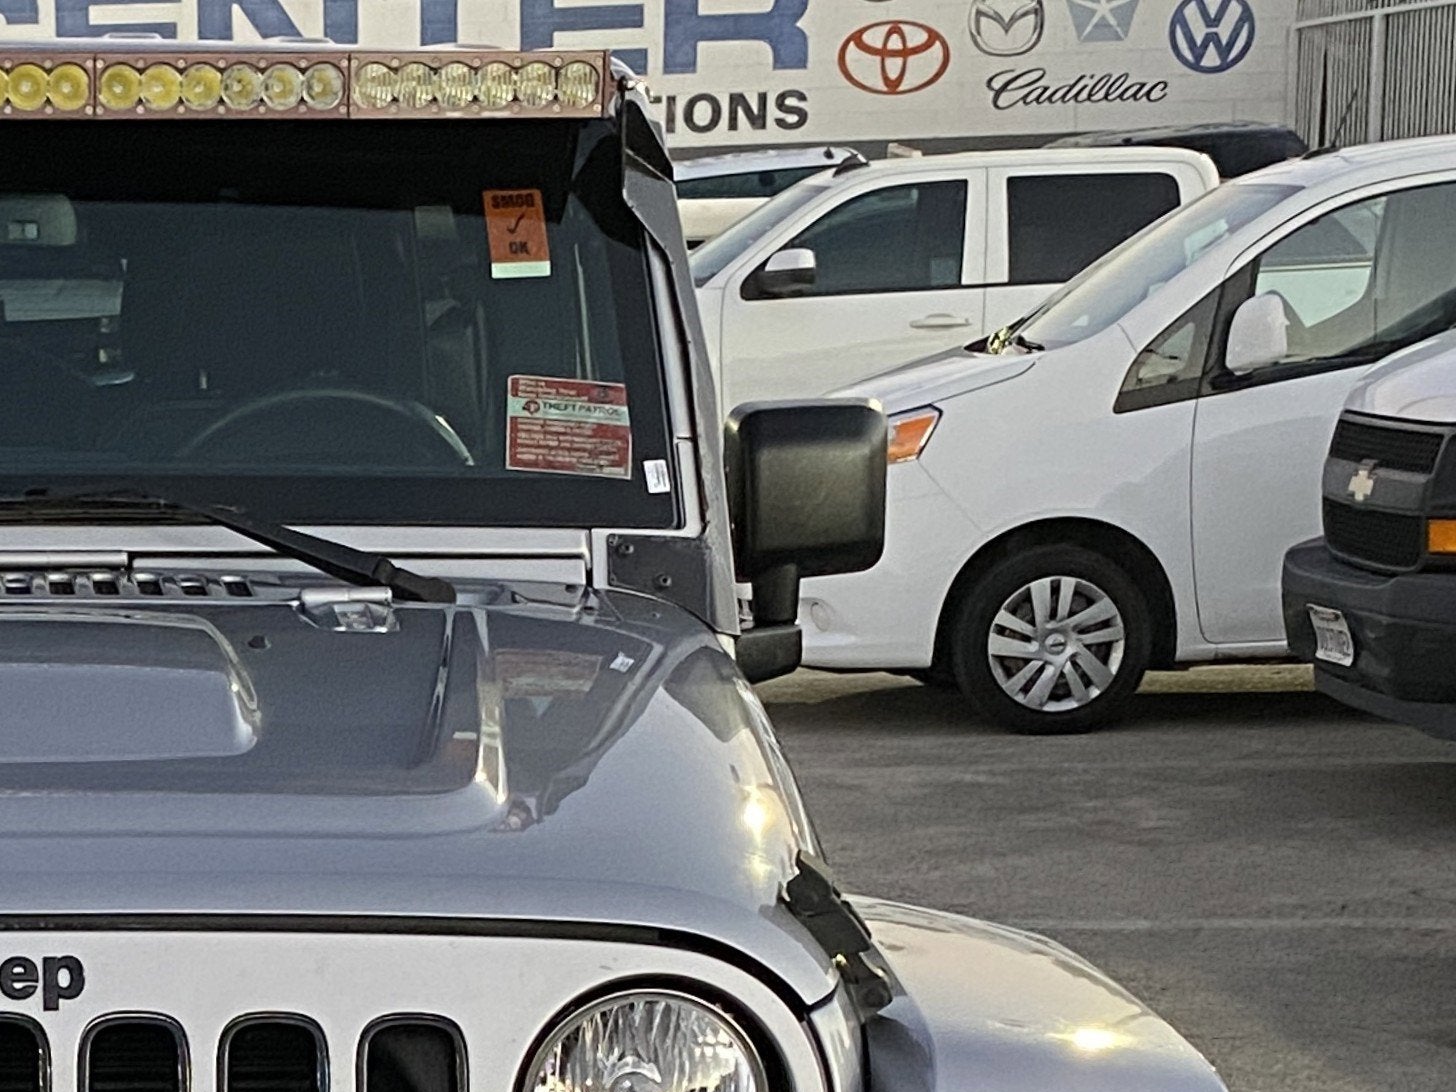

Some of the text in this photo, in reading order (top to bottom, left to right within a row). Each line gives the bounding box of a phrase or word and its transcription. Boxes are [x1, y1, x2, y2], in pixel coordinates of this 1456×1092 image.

[986, 68, 1169, 110] Cadillac
[649, 89, 809, 134] IONS
[509, 241, 531, 256] OK
